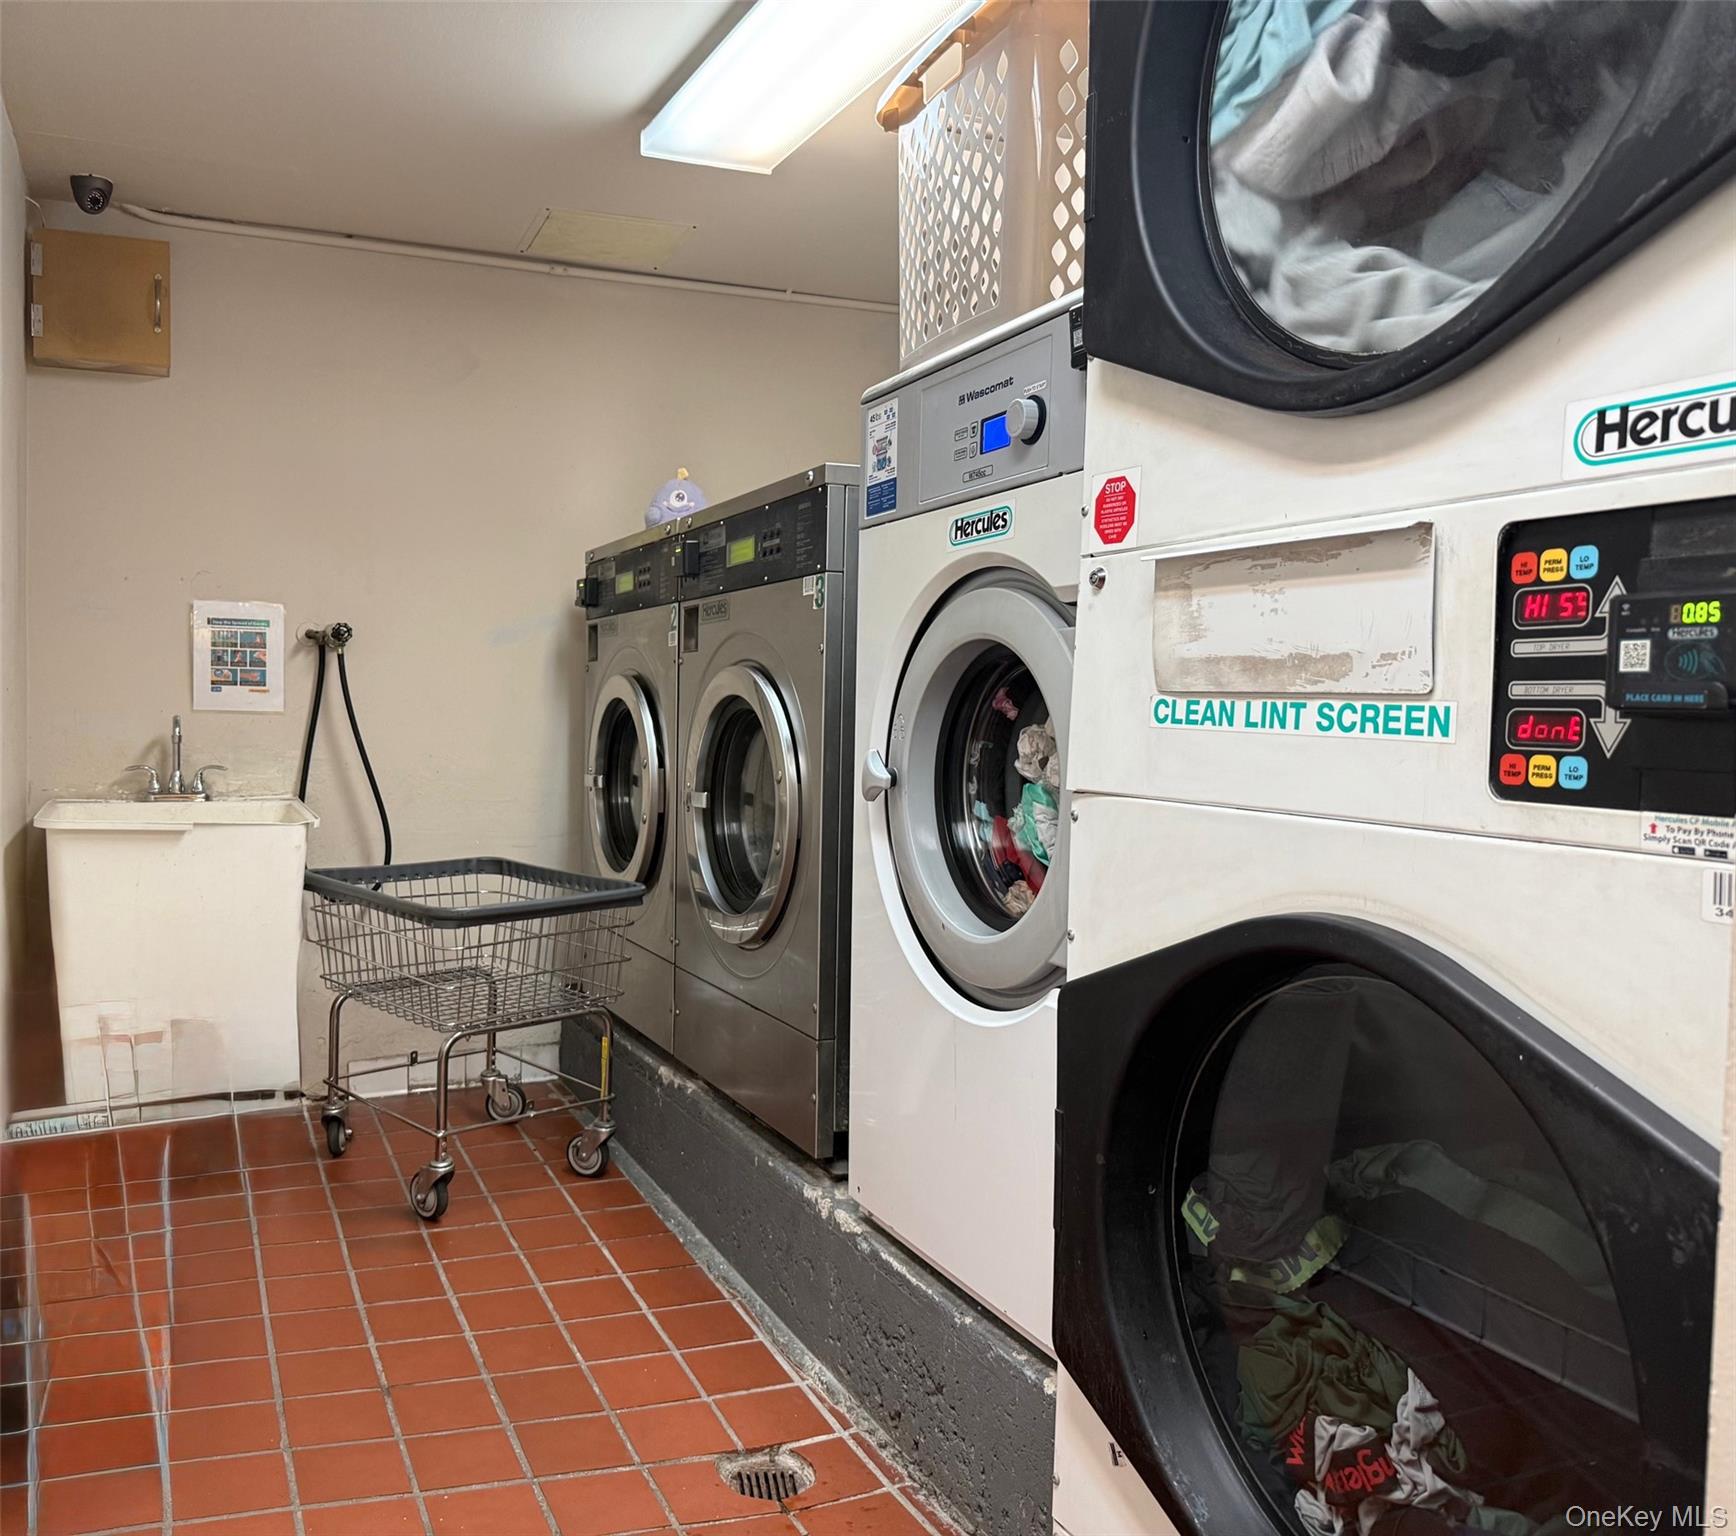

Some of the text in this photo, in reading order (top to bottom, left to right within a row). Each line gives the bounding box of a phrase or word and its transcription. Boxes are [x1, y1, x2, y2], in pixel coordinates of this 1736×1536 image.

[966, 376, 1014, 403] Wascomat
[1105, 482, 1126, 494] STOP
[955, 510, 1008, 540] Hercules
[1544, 558, 1562, 566] PERM
[1579, 555, 1590, 563] LO
[1542, 566, 1564, 574] PRESS
[1575, 563, 1594, 571] TEMP
[815, 575, 824, 608] 3
[1524, 592, 1551, 620] HI
[671, 605, 677, 631] 2
[1549, 643, 1571, 651] DRYER
[1523, 686, 1574, 694] BOTTOM DRYER
[1625, 693, 1649, 702] PLACE
[1651, 693, 1672, 703] CARD
[1153, 699, 1451, 737] CLEAN LINT SCREEN
[1533, 764, 1551, 772] PERM
[1531, 771, 1553, 779] PRESS
[1564, 773, 1584, 781] TEMP
[1666, 825, 1735, 839] To Pay By Phone
[1643, 832, 1671, 845] Simply
[1672, 836, 1693, 846] Scan
[1694, 838, 1706, 847] QR
[1709, 839, 1730, 849] Code
